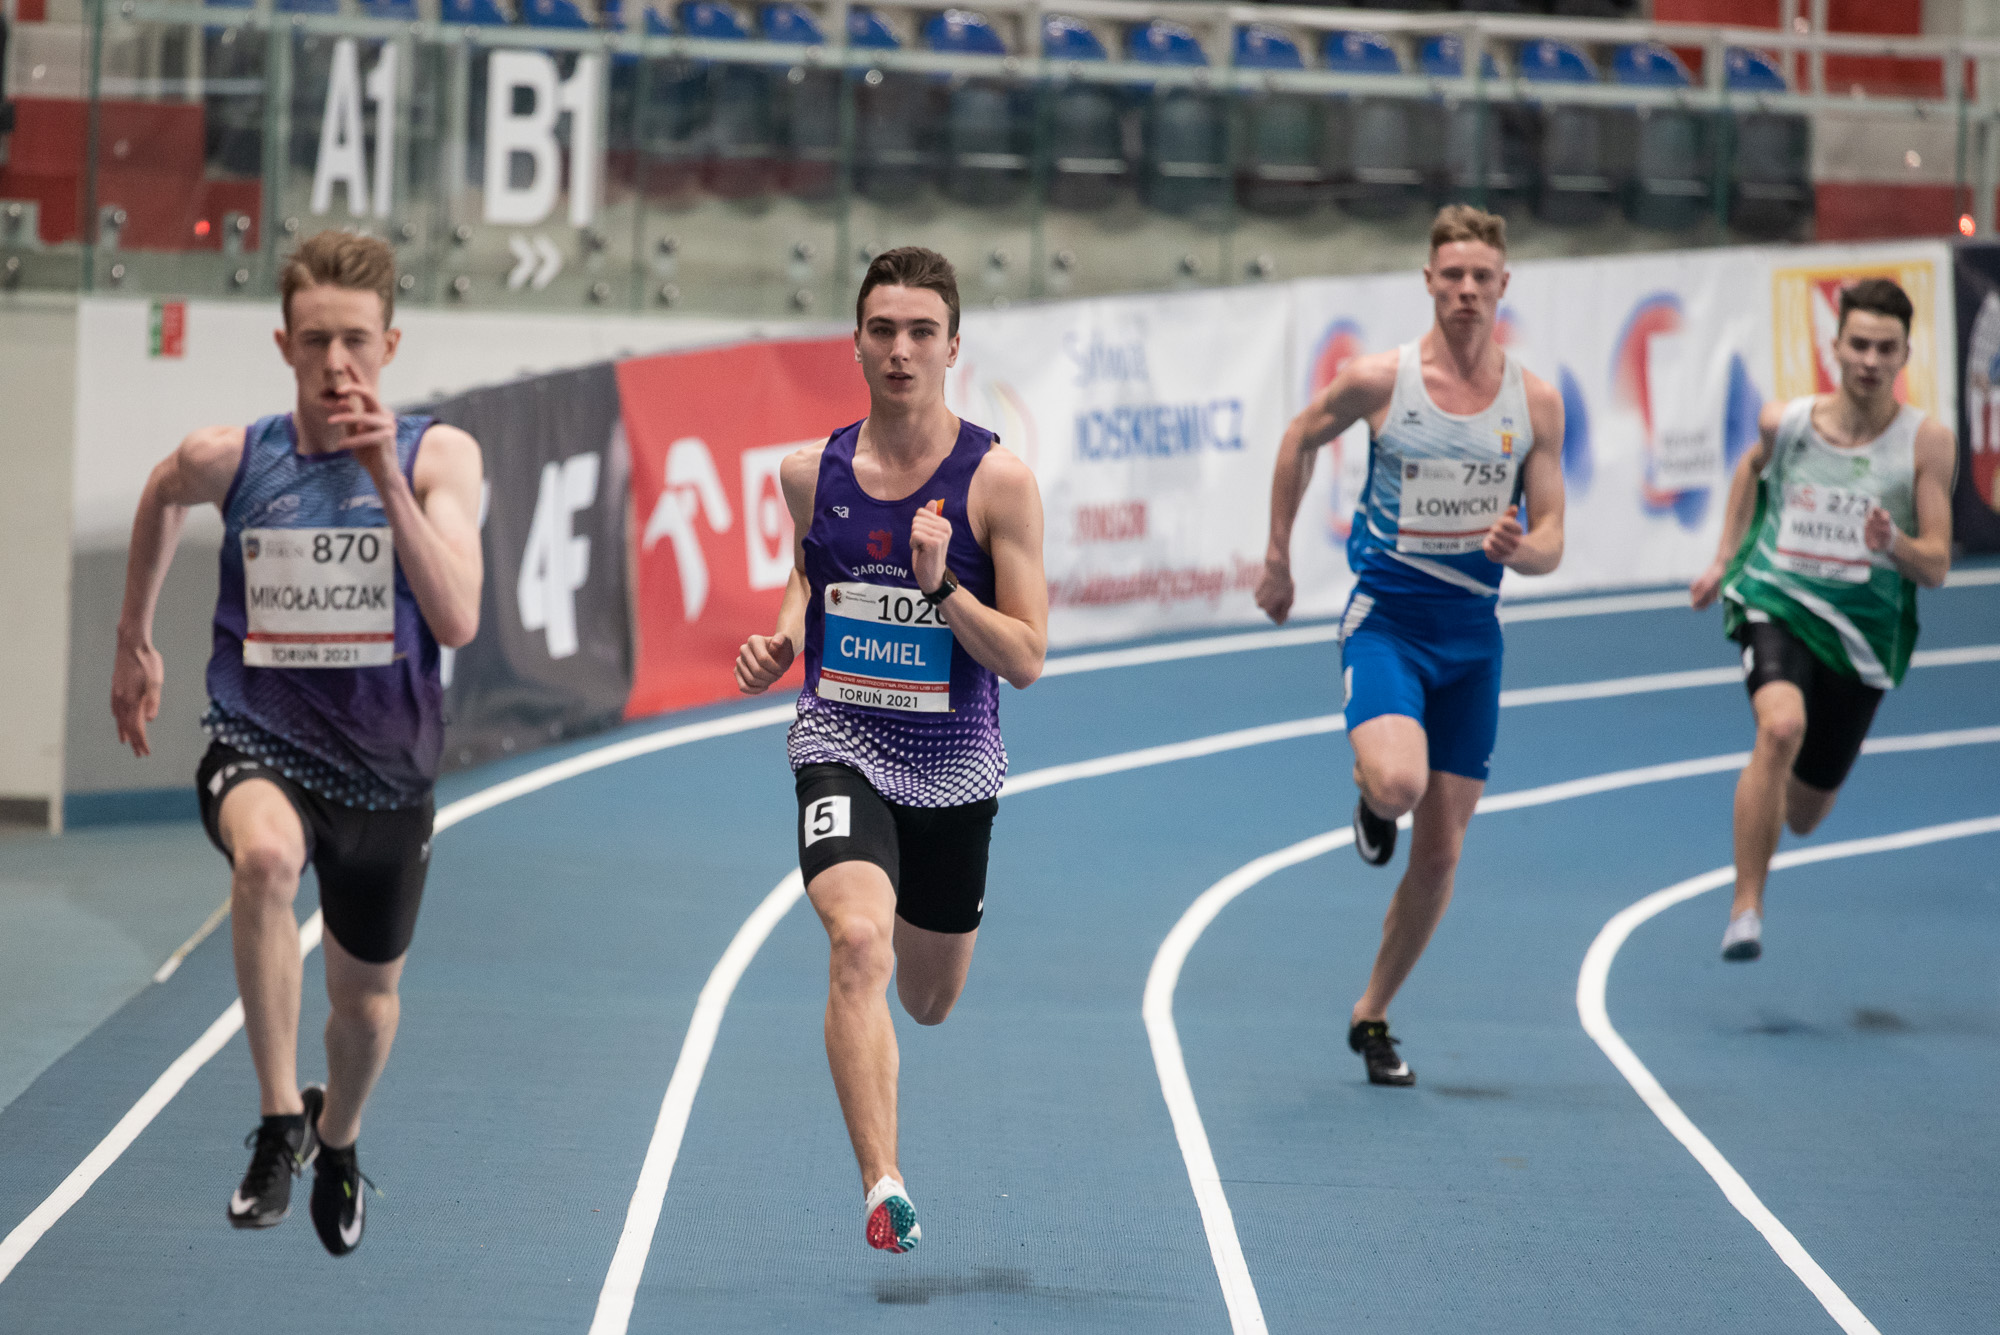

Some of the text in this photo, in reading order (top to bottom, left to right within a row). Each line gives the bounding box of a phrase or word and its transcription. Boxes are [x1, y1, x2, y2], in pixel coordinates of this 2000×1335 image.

[310, 38, 398, 218] A1
[485, 49, 600, 228] B1
[1462, 463, 1507, 485] 755
[1415, 495, 1499, 516] ŁOWICKI
[313, 533, 379, 564] 870
[517, 451, 600, 660] 4F
[851, 564, 908, 579] JAROCIN
[250, 585, 387, 611] MIKOŁAJCZAK
[324, 649, 360, 663] 2021
[840, 635, 926, 667] CHMIEL
[839, 687, 918, 709] TORUŃ 2021
[813, 801, 838, 837] 5
